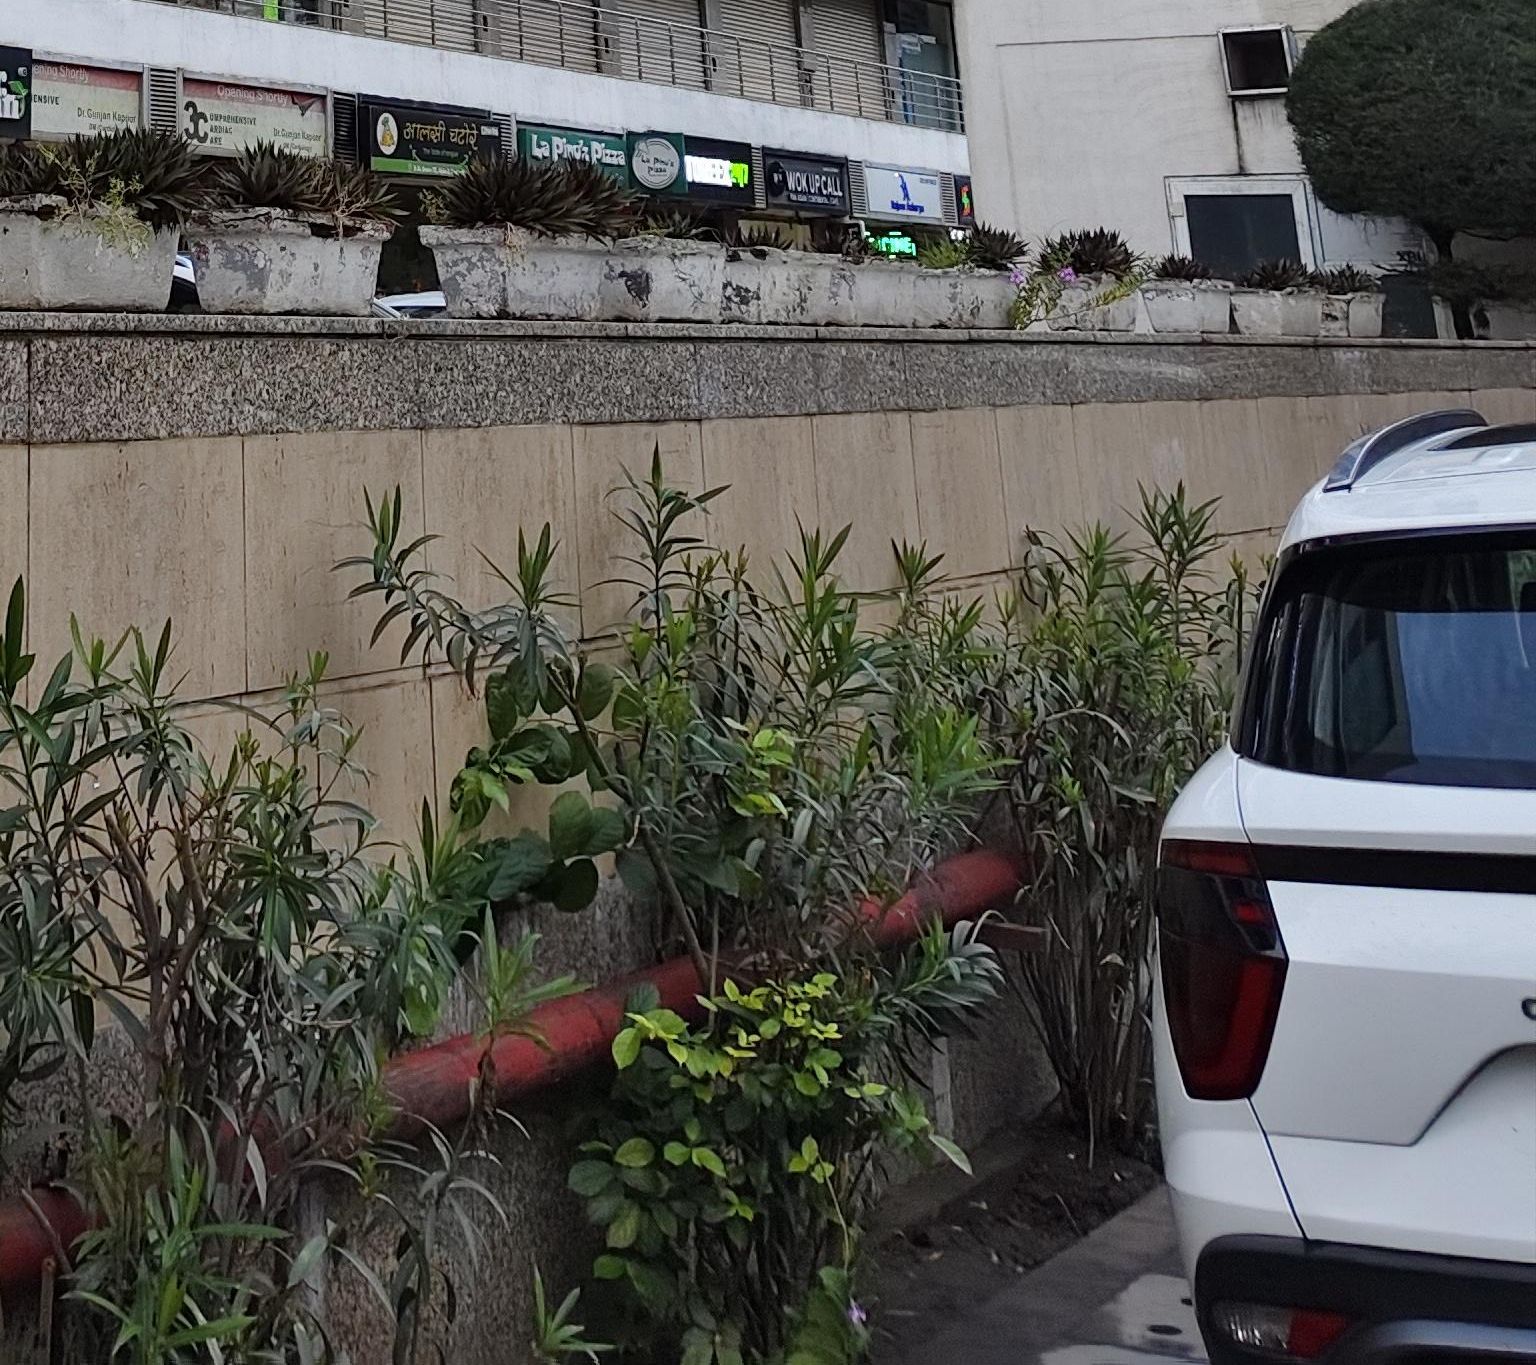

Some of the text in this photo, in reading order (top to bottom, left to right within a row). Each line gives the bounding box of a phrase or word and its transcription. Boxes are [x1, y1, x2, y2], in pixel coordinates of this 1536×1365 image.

[59, 66, 90, 84] Shortly
[217, 84, 289, 107] Opening Shortly
[403, 120, 446, 143] आलसी
[449, 122, 479, 150] चटोरे
[531, 134, 550, 161] La
[590, 141, 627, 166] Pizza
[785, 171, 843, 197] WOK UP CALL
